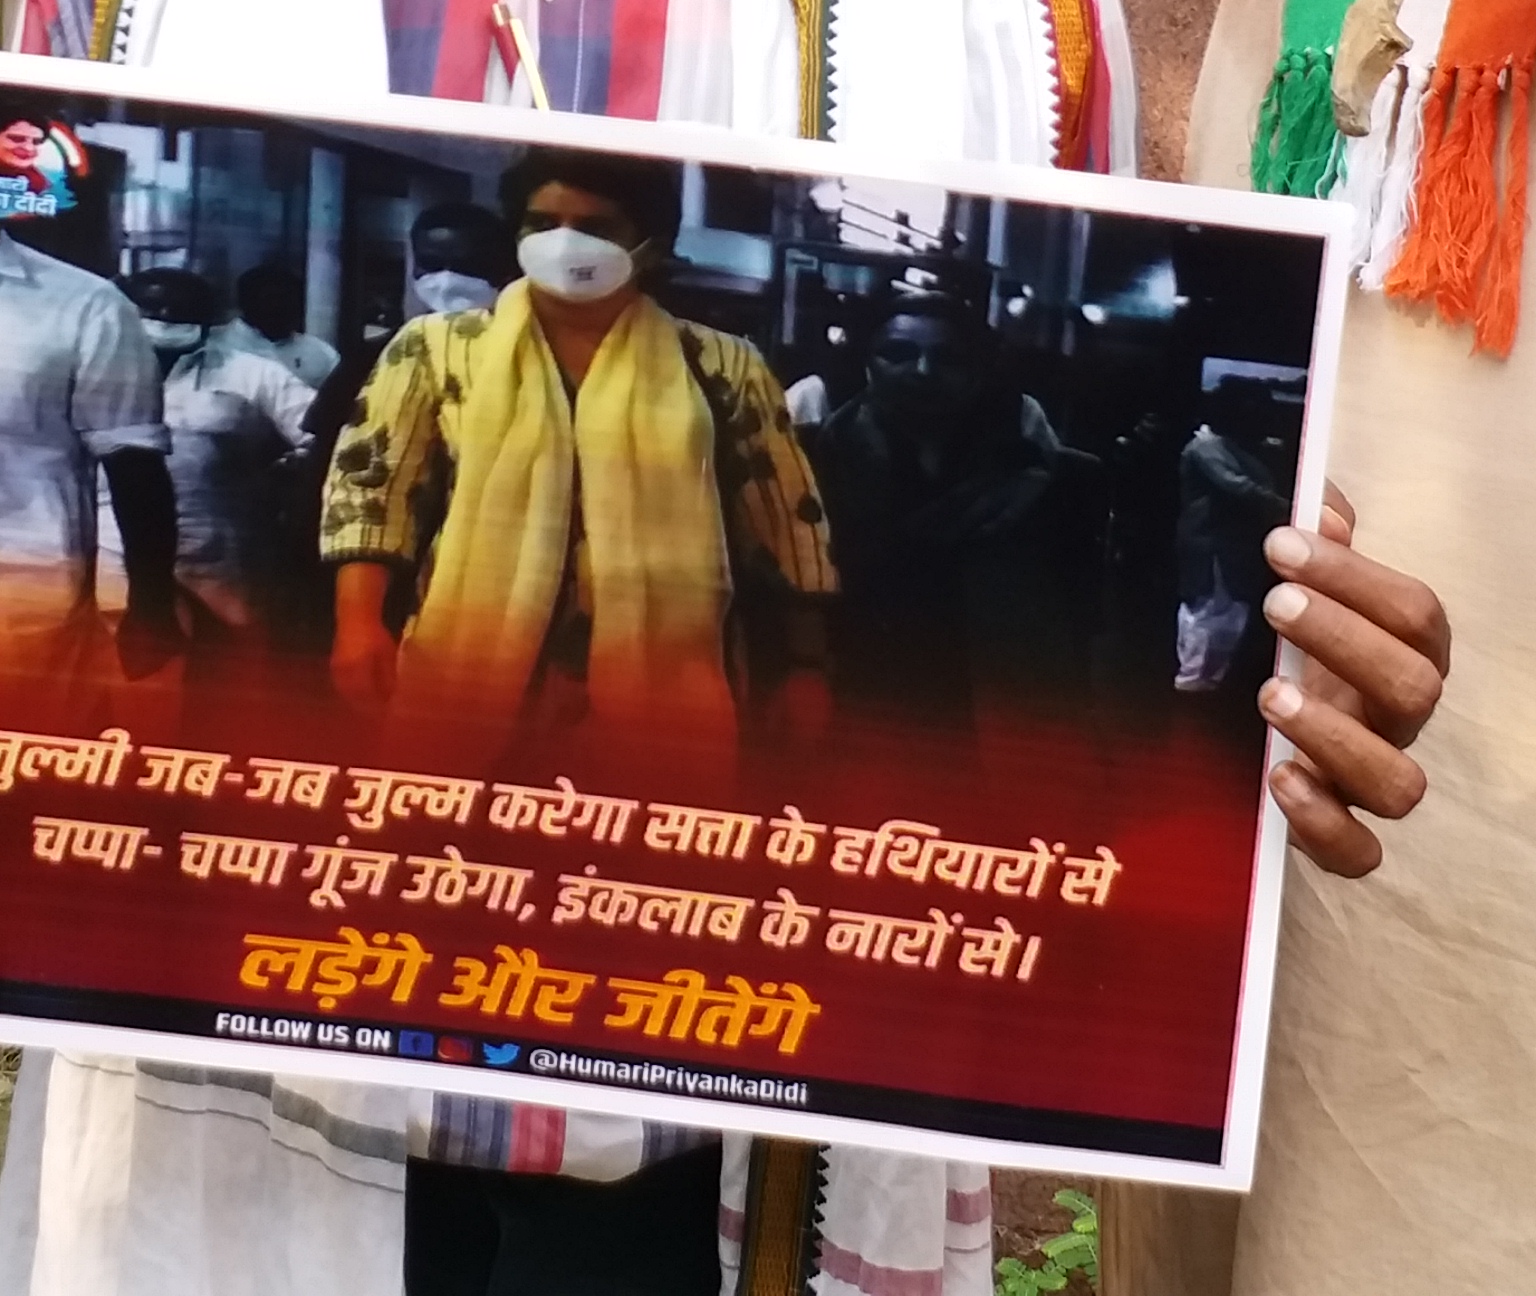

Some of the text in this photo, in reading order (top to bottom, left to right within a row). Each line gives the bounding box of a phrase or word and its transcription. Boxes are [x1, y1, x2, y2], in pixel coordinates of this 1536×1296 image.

[344, 766, 485, 831] जुल्म
[488, 775, 639, 844] करेगा
[643, 802, 762, 860] सत्ता
[766, 805, 826, 867] के
[830, 818, 1066, 899] हथियारों
[1061, 846, 1122, 906] से
[180, 831, 298, 885] चप्पा
[301, 834, 398, 910] गूंज
[400, 844, 537, 923] उठेगा,
[552, 864, 755, 943] इंकलाब
[759, 887, 820, 948] के
[825, 907, 964, 969] नारों
[958, 916, 1042, 983] से।
[238, 926, 822, 1054] लड़ेंगे और जीतेंगे
[214, 1011, 809, 1105] FOLLOW US ON @HumariPriyankaDidi
